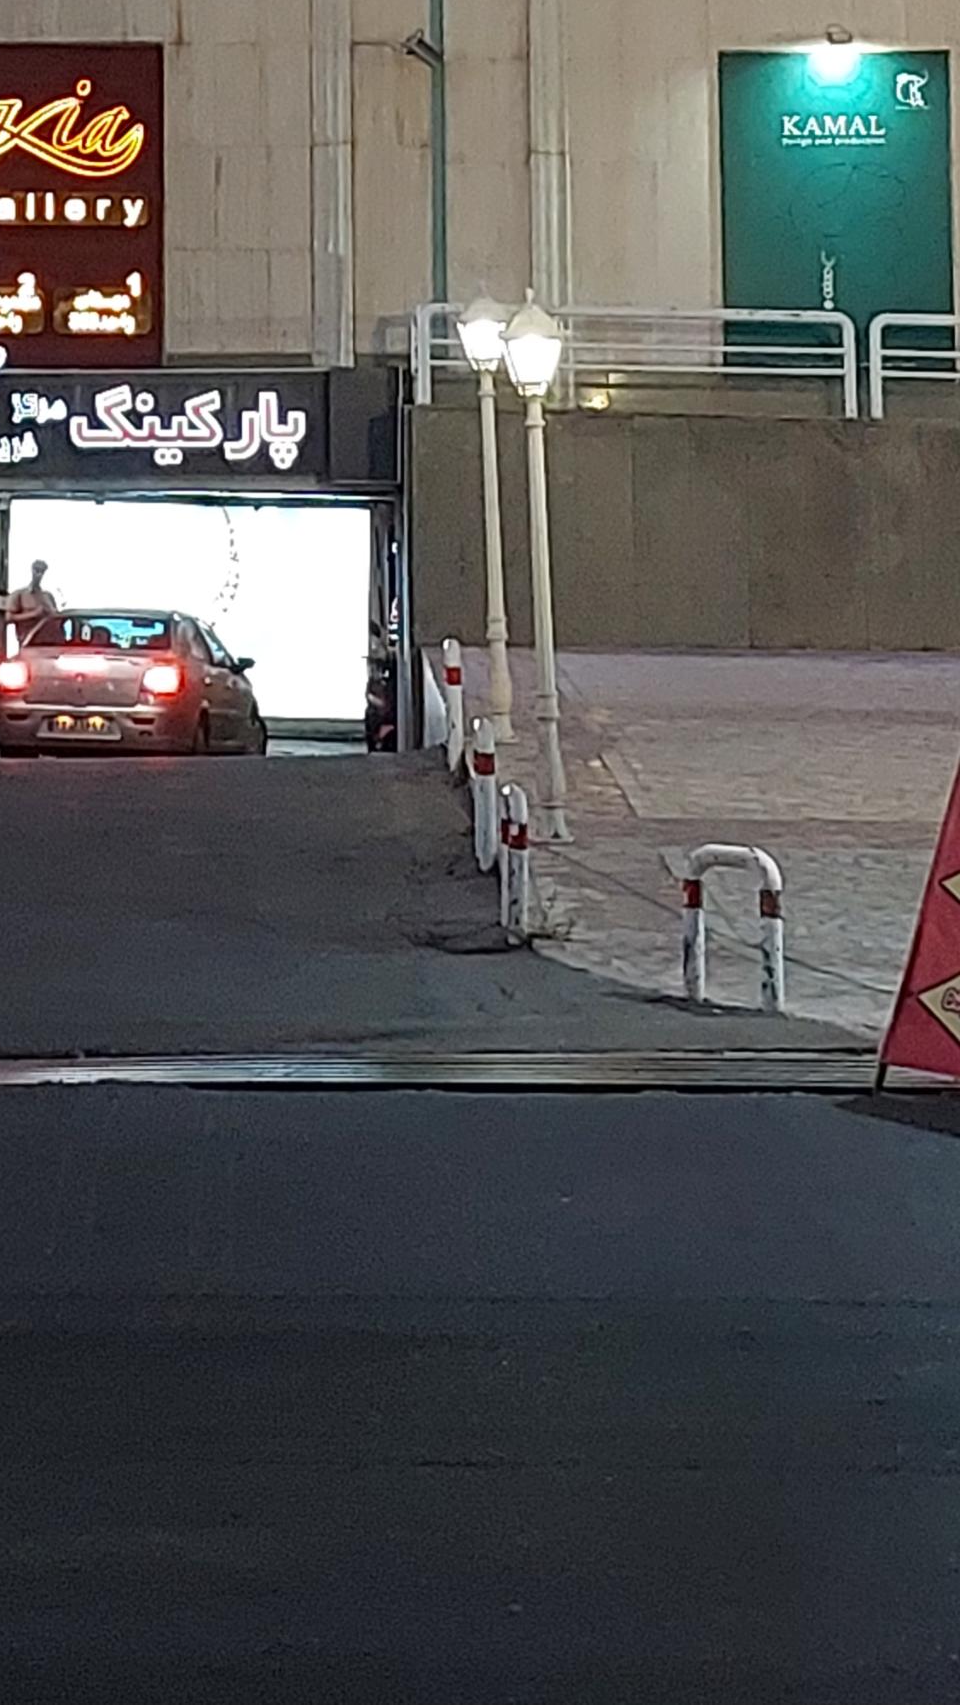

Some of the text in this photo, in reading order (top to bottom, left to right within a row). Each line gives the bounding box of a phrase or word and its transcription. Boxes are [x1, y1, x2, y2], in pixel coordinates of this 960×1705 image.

[782, 115, 886, 136] KAMAL
[126, 271, 141, 297] 1
[11, 393, 68, 424] مرکز
[69, 384, 306, 469] پارکینگ
